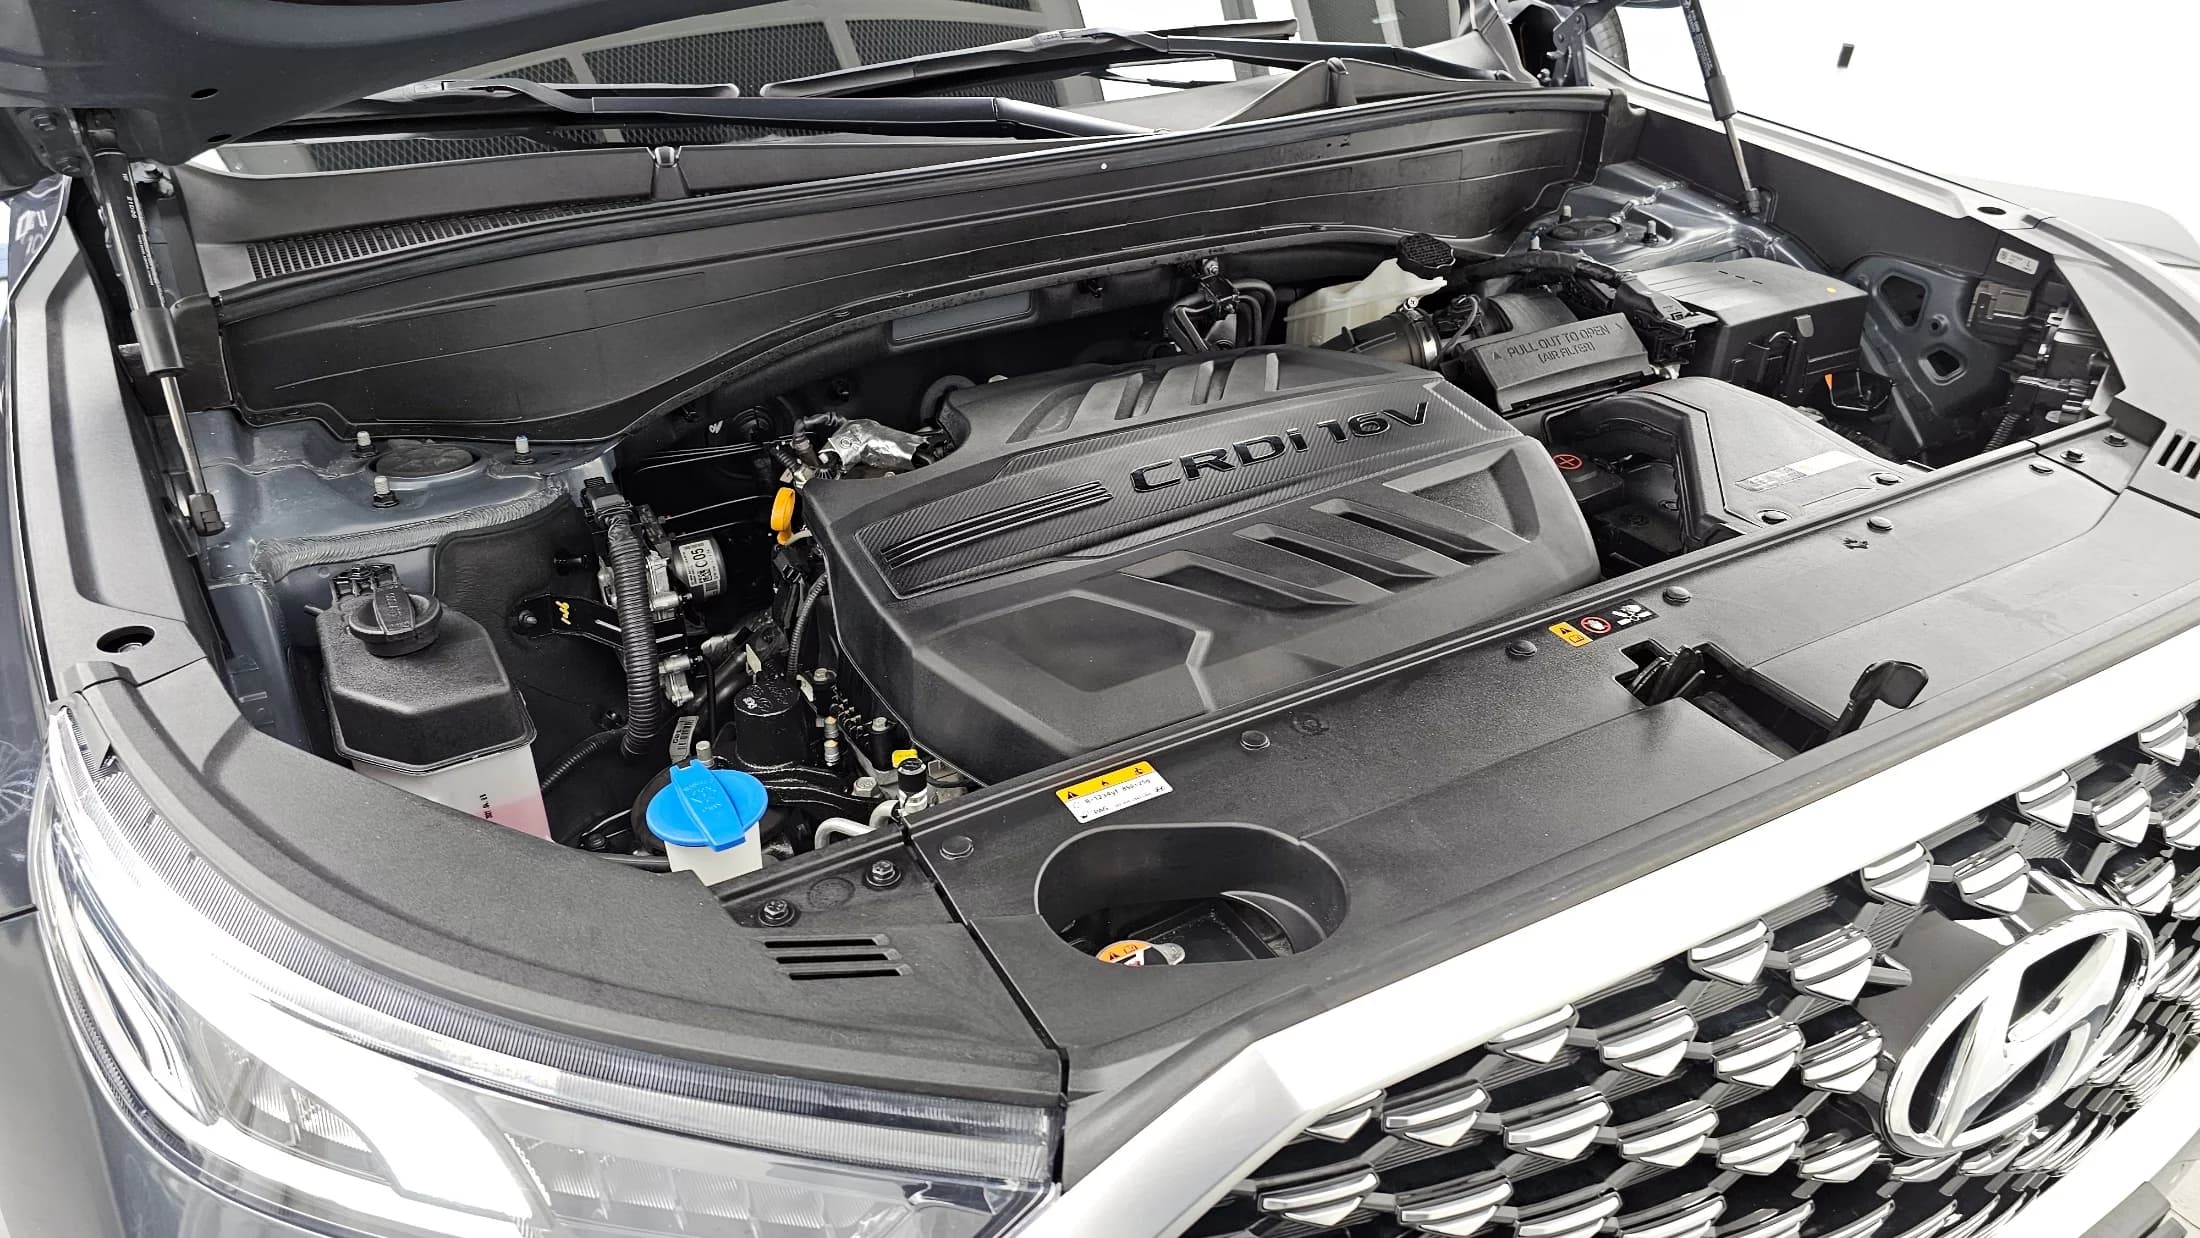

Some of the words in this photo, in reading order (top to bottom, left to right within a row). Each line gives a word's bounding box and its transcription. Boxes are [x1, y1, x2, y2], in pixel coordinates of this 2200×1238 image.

[1507, 342, 1538, 357] PULL
[1539, 335, 1562, 349] OUT
[1563, 331, 1579, 343] TO
[1579, 324, 1610, 339] OPEN
[1537, 350, 1560, 364] (AIR
[1560, 342, 1596, 357] FILTER)
[1129, 427, 1310, 493] CRDi
[1316, 400, 1429, 443] 16V
